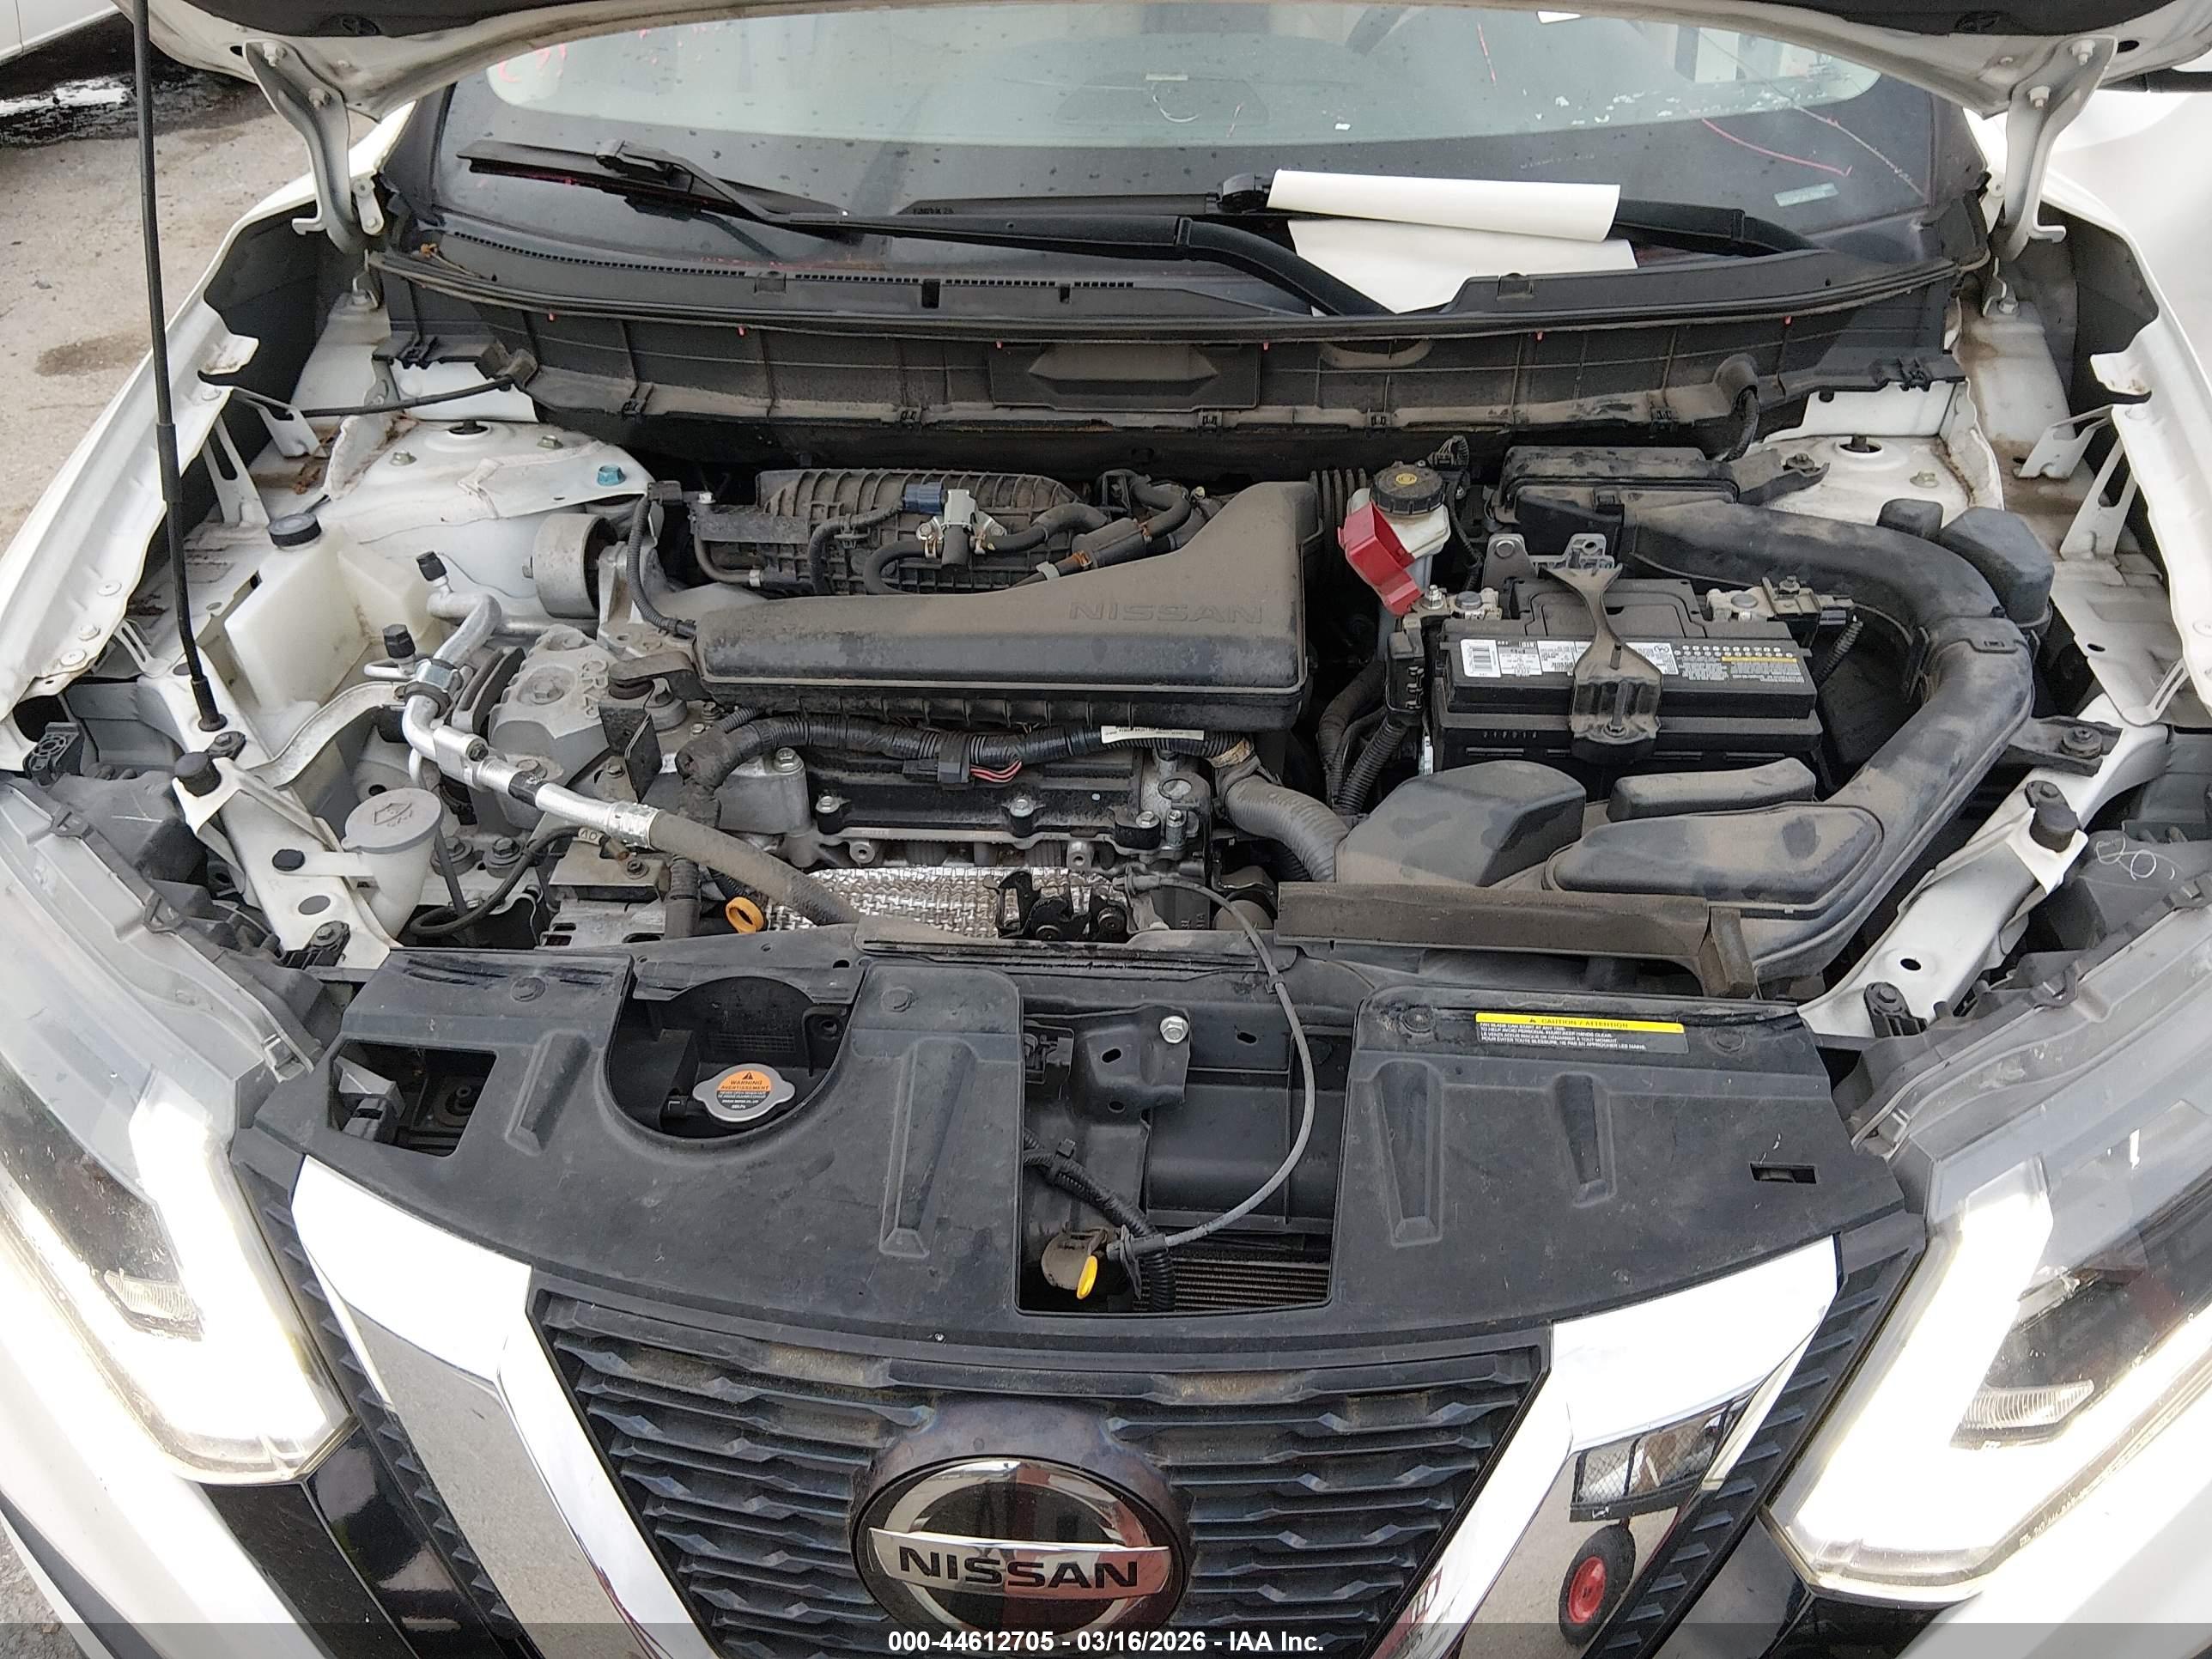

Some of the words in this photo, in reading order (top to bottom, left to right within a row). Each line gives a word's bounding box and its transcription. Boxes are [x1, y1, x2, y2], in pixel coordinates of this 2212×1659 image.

[1068, 602, 1263, 624] NISSAN
[1585, 1020, 1628, 1029] ATTENTION
[897, 1547, 1139, 1589] NISSAN
